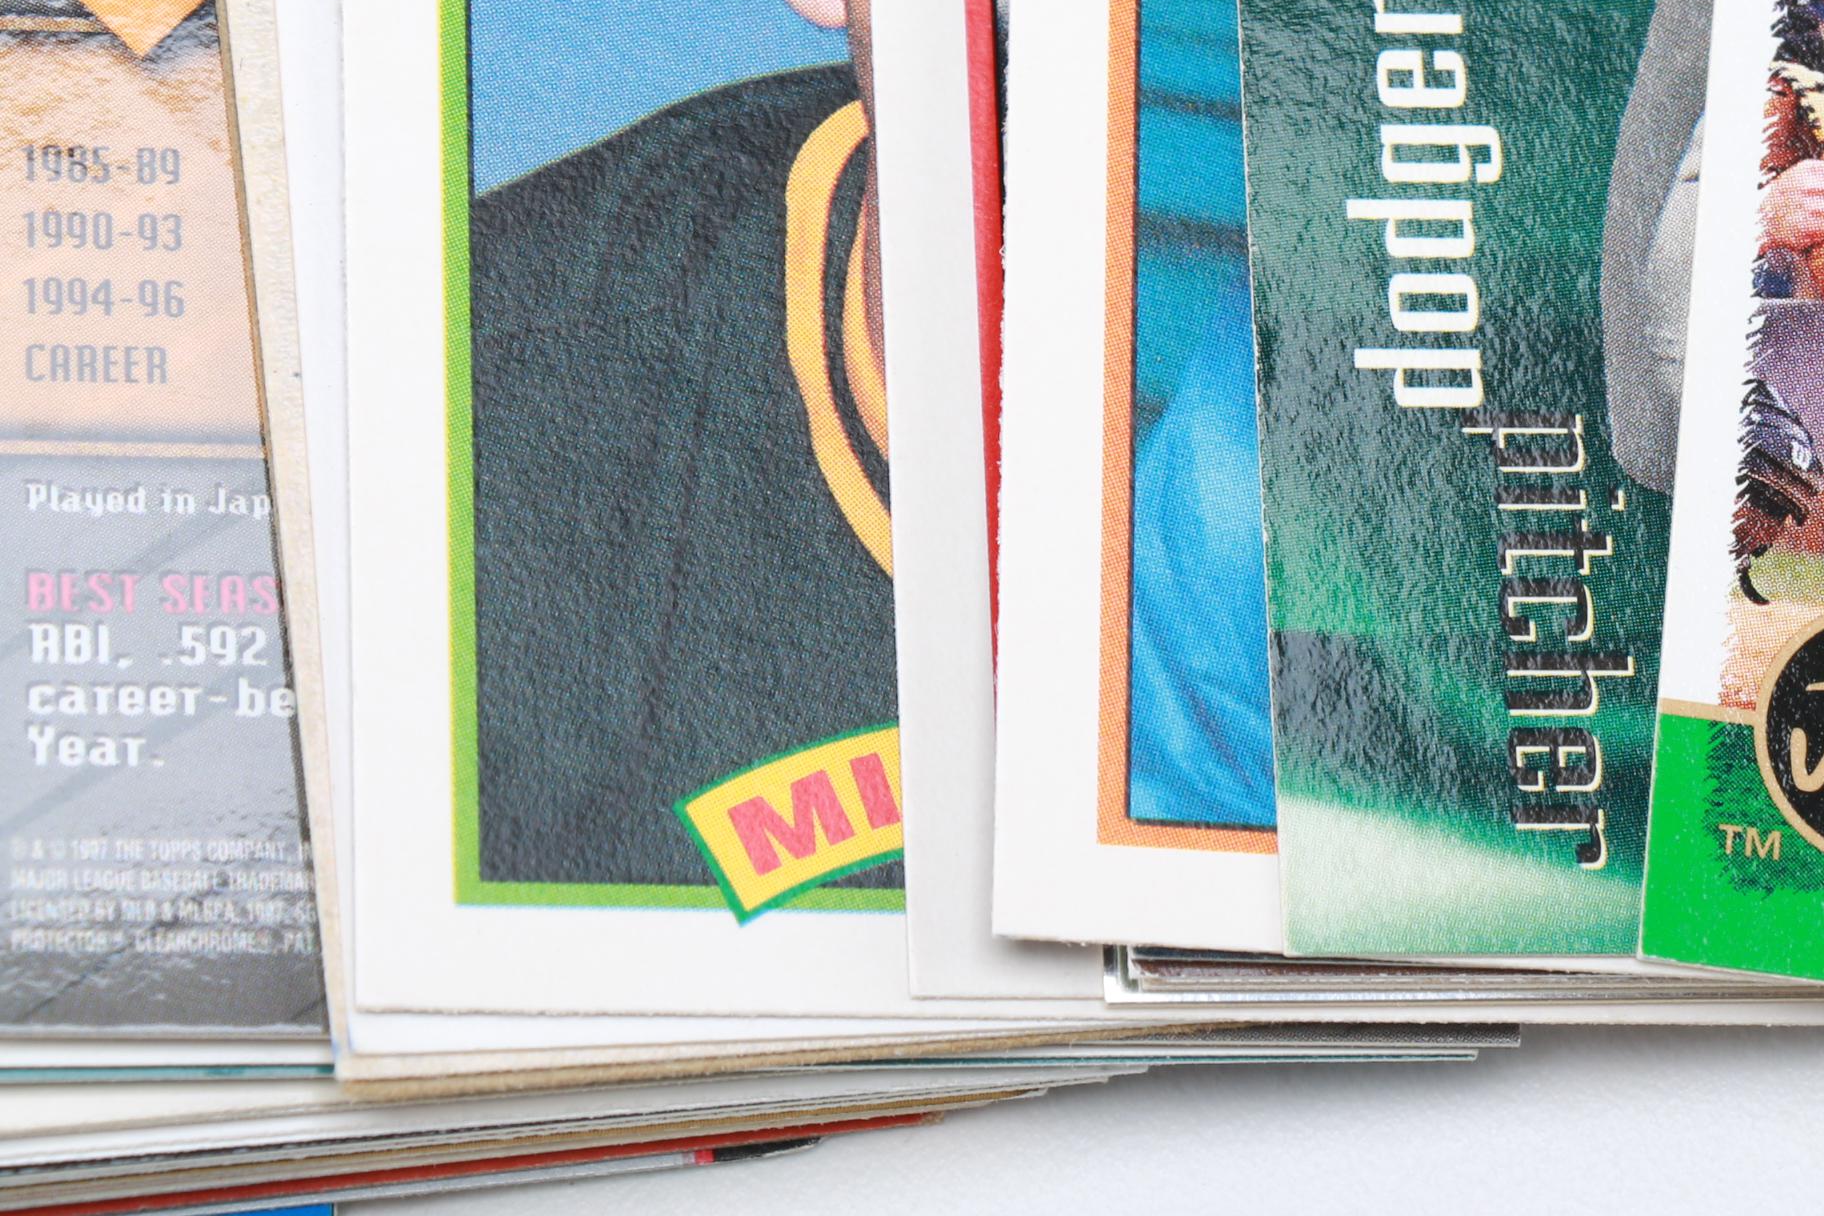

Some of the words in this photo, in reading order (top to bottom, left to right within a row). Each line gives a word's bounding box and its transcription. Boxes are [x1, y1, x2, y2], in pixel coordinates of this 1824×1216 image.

[21, 144, 182, 186] 1985-89
[22, 210, 184, 252] 1990-93
[22, 277, 186, 318] 1994-96
[24, 343, 169, 385] CAREER
[26, 480, 147, 518] Played
[161, 485, 197, 515] in
[27, 570, 140, 616] BEST
[161, 573, 279, 616] SEAS
[161, 625, 270, 667] .592
[1462, 412, 1636, 870] pitcher
[27, 724, 167, 769] Year.
[114, 839, 144, 861] THE
[150, 839, 202, 861] TOPPS
[1718, 823, 1783, 862] TM
[74, 868, 136, 891] LEAGUE
